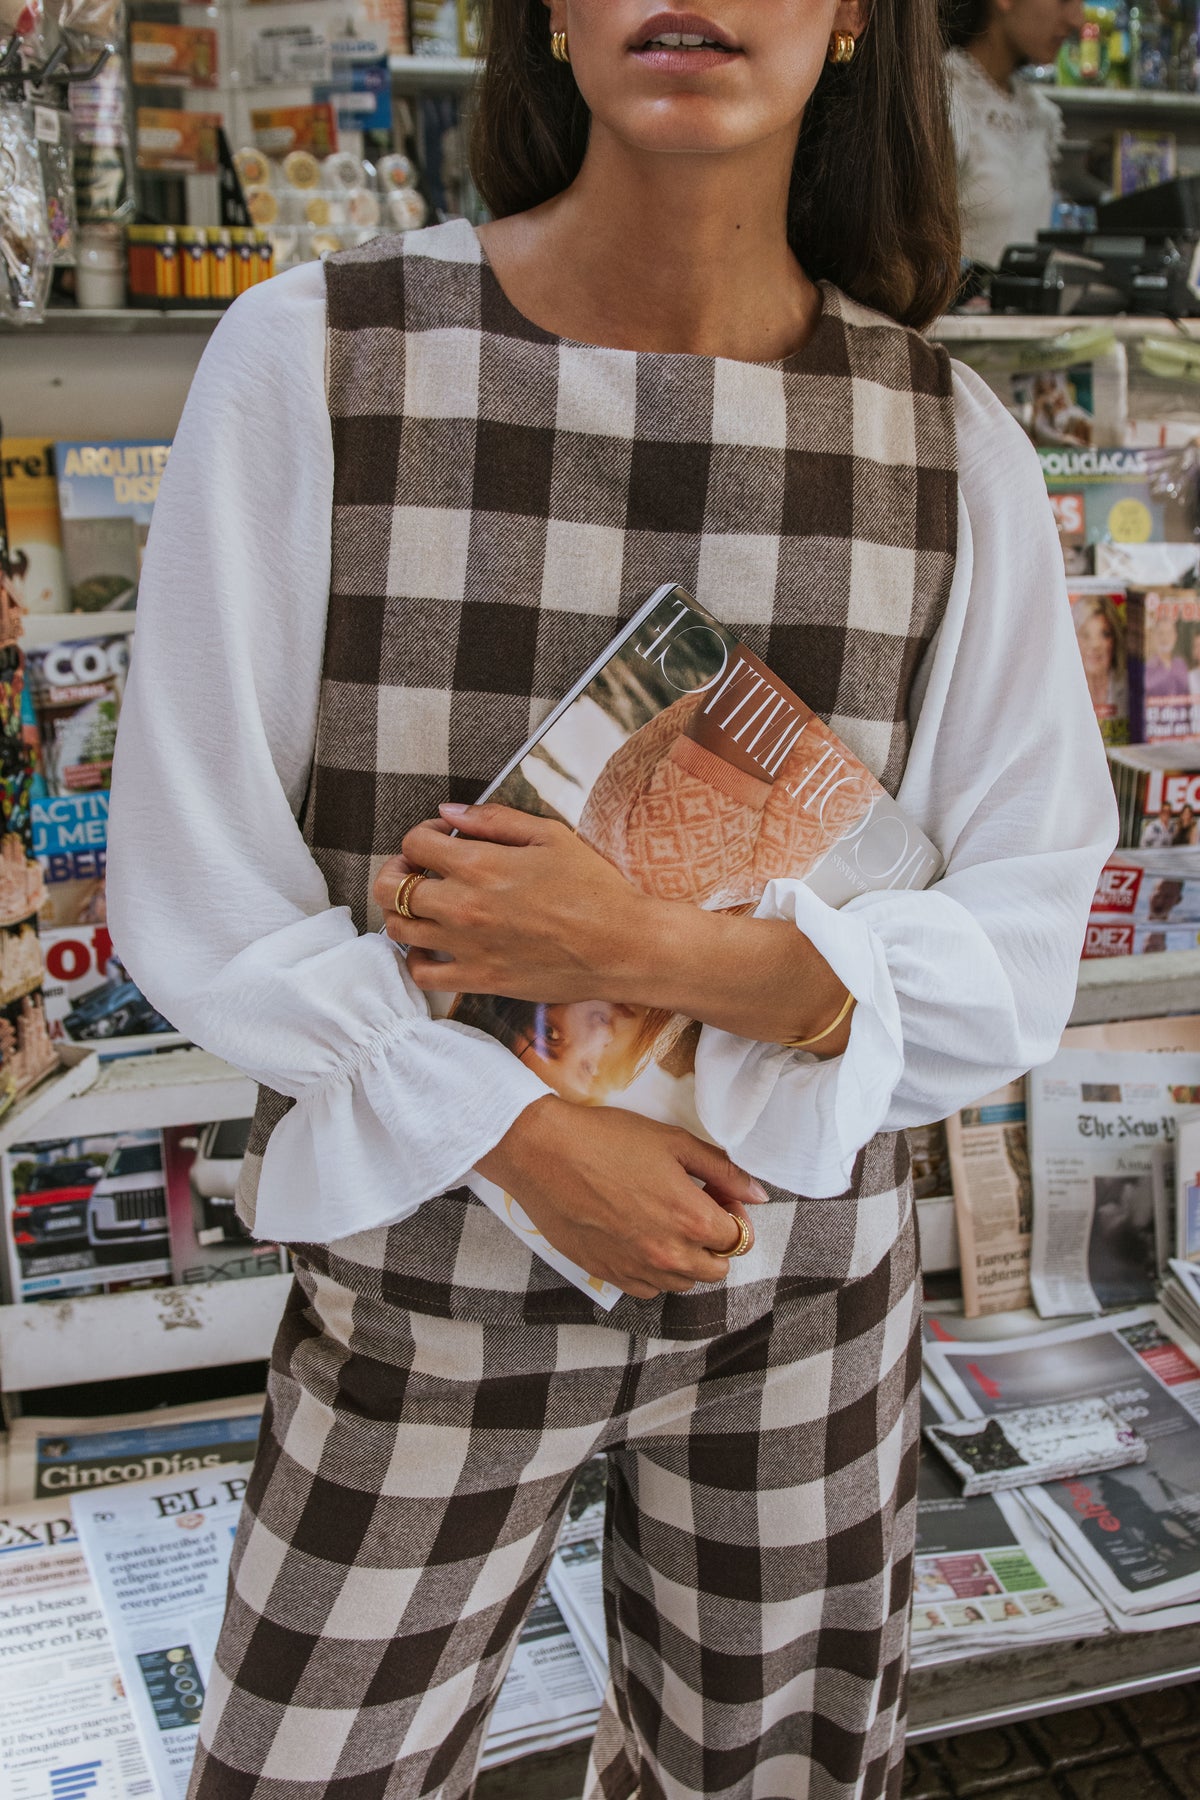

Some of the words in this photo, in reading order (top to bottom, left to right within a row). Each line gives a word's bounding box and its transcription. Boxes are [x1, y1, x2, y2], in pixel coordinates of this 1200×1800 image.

[634, 599, 808, 777] WALLACE
[1077, 1114, 1116, 1139] The
[1117, 1115, 1159, 1138] New
[40, 1454, 222, 1490] CincoDías
[152, 1487, 217, 1518] EL
